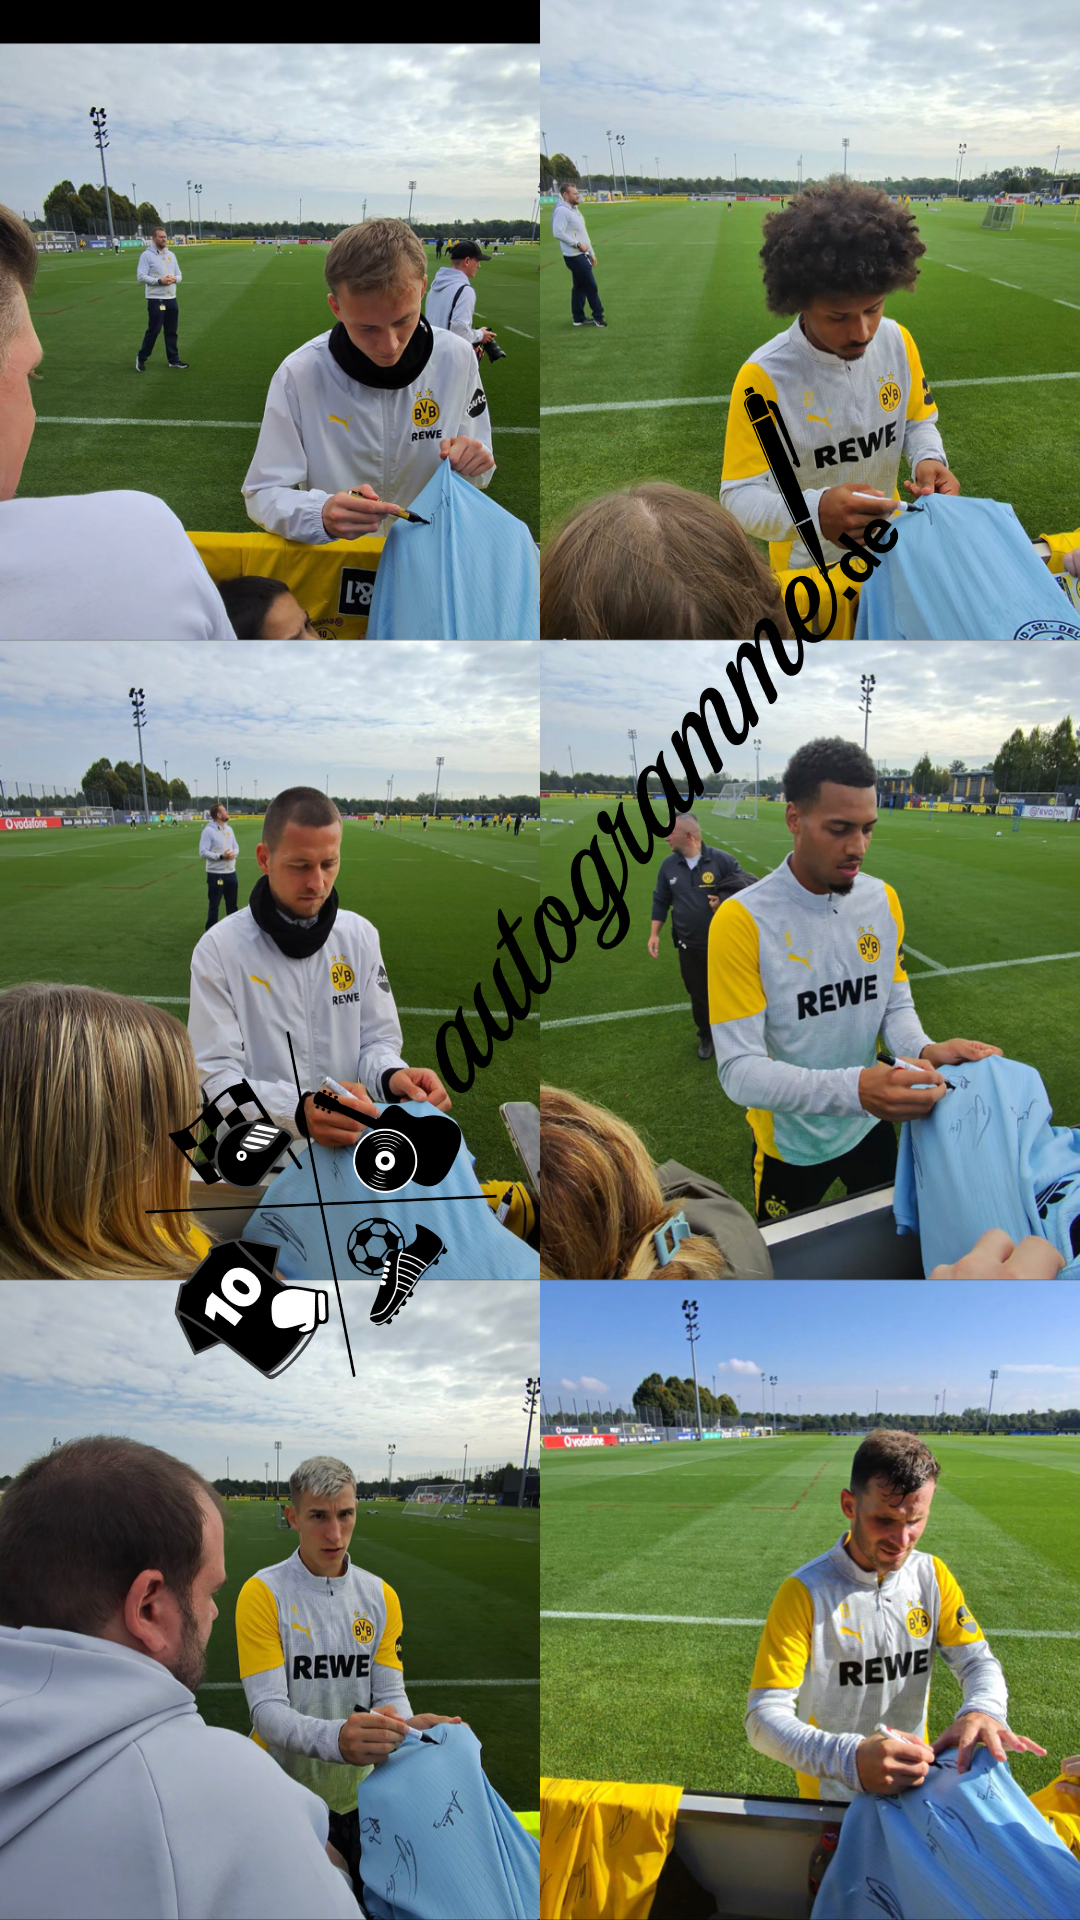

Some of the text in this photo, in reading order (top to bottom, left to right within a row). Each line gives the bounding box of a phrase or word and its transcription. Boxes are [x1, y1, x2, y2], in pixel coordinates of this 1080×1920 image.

[882, 384, 899, 406] BVB
[414, 401, 437, 420] BVB
[420, 417, 430, 425] 09
[411, 429, 443, 442] REWE
[814, 420, 897, 469] REWE
[13, 817, 47, 830] vodafone
[860, 936, 878, 955] BVB
[332, 965, 352, 984] BVB
[332, 992, 361, 1006] REWE
[797, 974, 878, 1021] REWE
[570, 1434, 605, 1447] vodafone
[354, 1620, 372, 1637] BVB
[908, 1610, 929, 1630] BVB
[293, 1654, 370, 1680] REWE
[839, 1648, 929, 1687] REWE
